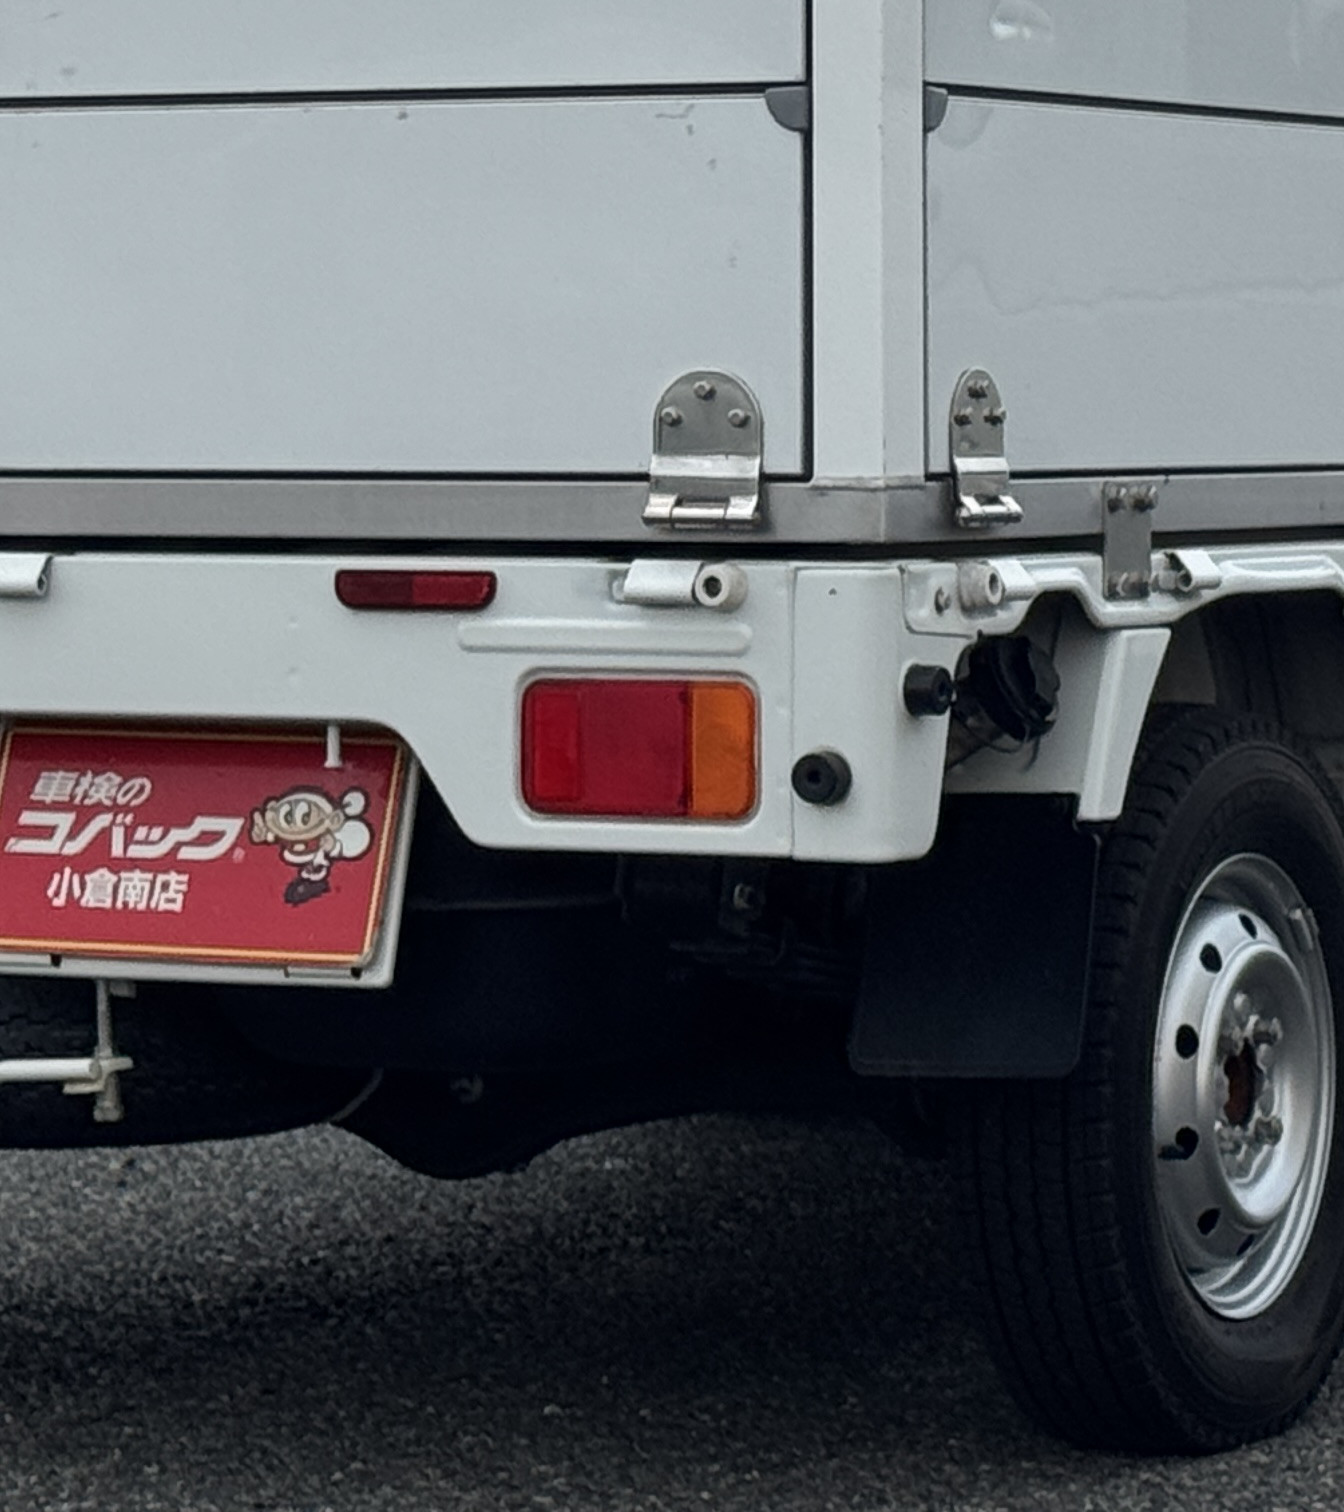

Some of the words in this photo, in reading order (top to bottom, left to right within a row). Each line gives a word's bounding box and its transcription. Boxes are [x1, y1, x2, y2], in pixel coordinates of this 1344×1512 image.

[29, 769, 153, 807] 車検の
[4, 810, 246, 861] コバック
[46, 866, 190, 914] 小倉南店
